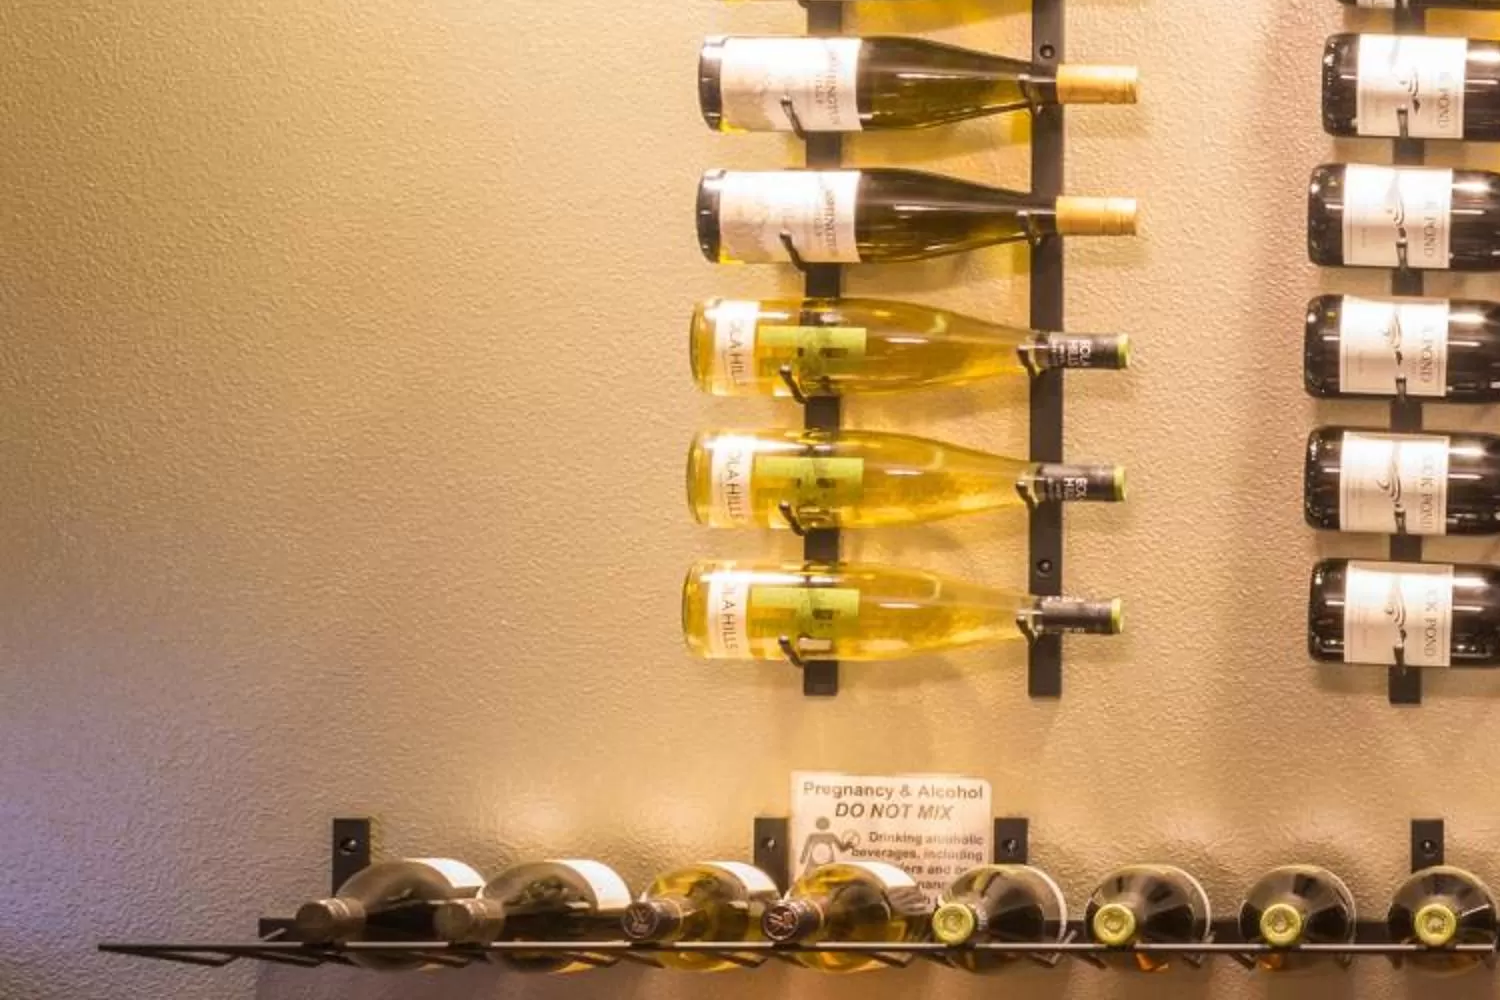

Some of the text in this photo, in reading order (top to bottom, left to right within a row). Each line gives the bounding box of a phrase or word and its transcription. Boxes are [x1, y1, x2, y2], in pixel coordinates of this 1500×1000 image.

[1424, 216, 1437, 257] POND
[1424, 618, 1437, 657] POND
[804, 781, 983, 800] Pregnancy & Alcohol
[835, 803, 954, 820] DO NOT MIX
[868, 831, 923, 846] Drinking
[927, 862, 950, 874] and
